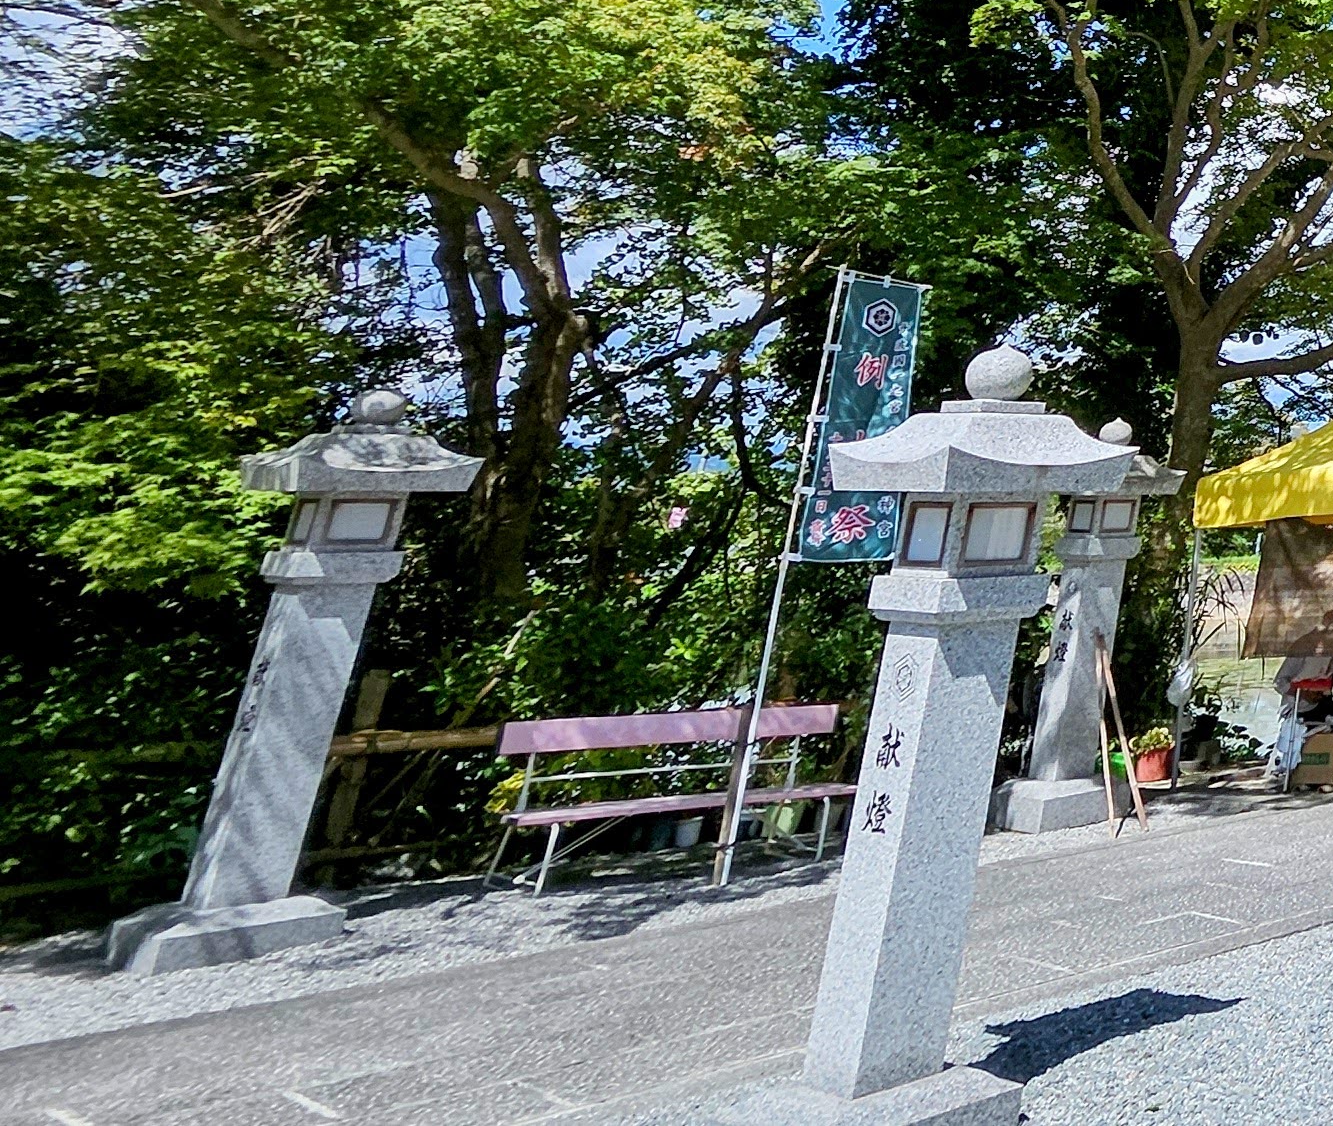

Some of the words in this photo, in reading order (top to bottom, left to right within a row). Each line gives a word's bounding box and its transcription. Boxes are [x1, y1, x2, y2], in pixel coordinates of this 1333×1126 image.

[815, 431, 844, 514] 十十一日
[826, 351, 889, 546] 例祭
[861, 722, 905, 835] 献燈
